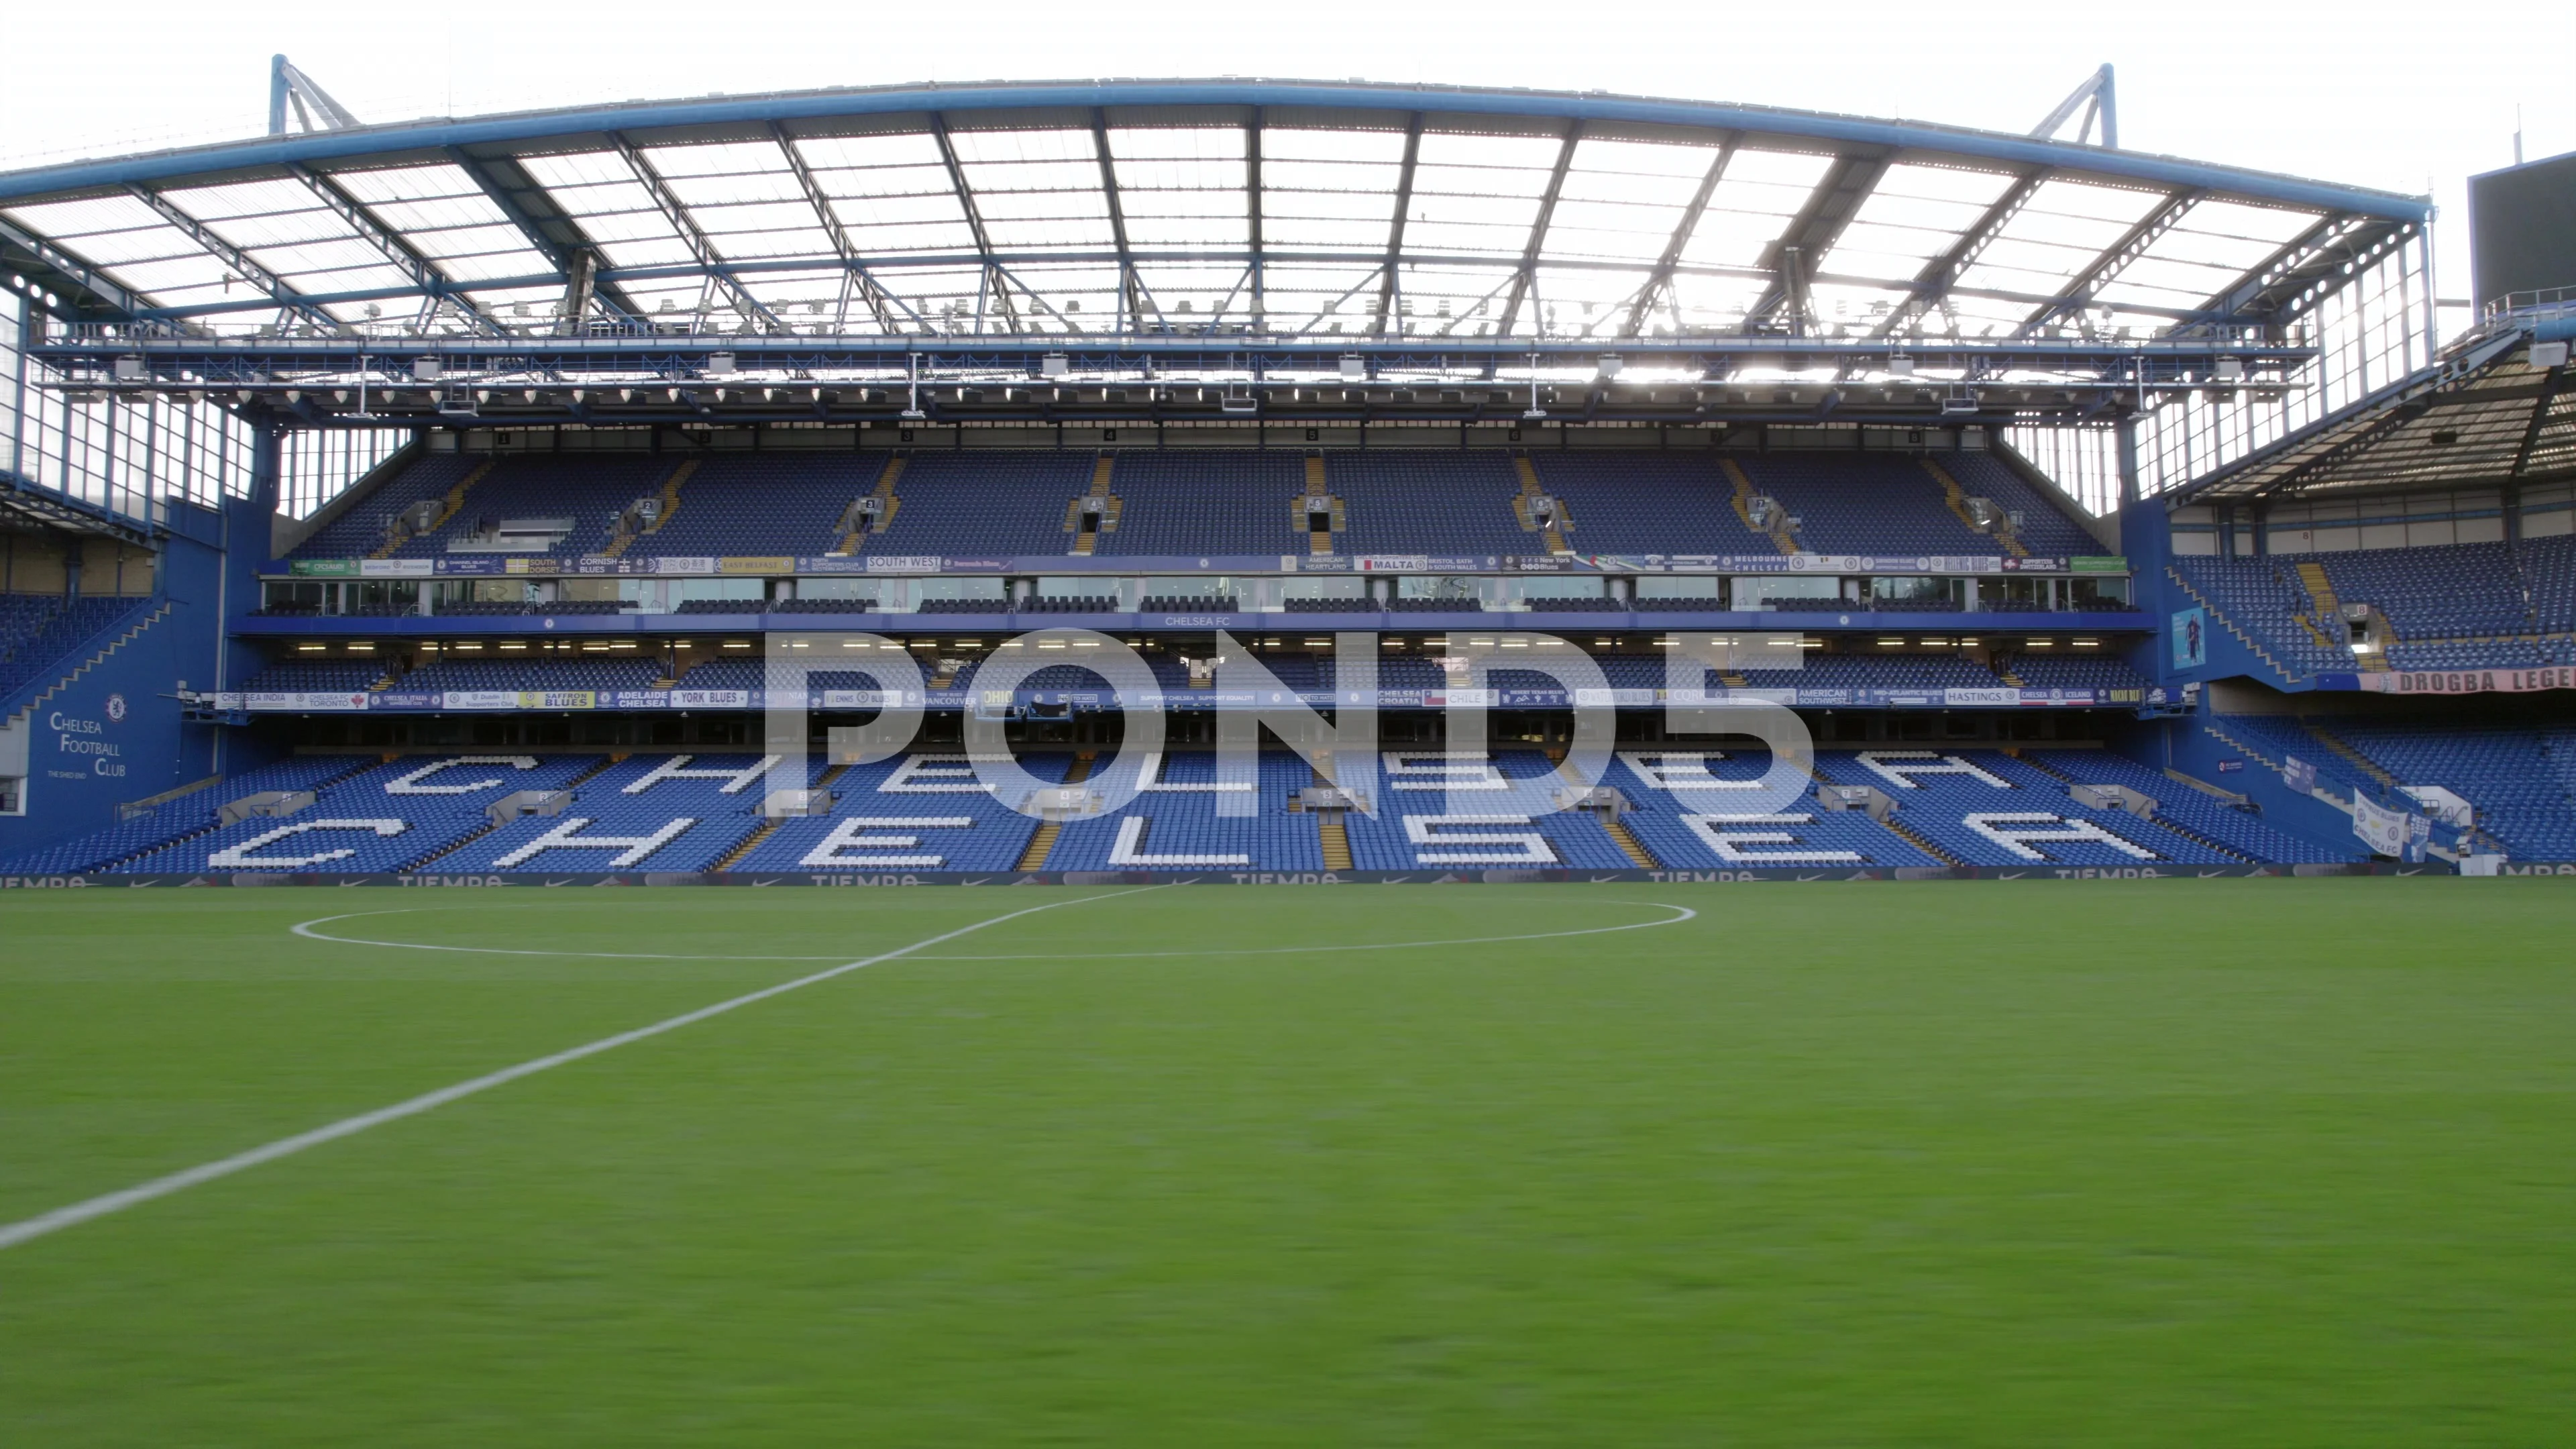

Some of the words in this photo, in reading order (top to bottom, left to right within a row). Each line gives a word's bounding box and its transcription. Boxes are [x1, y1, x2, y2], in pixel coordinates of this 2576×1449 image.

[904, 432, 910, 441] 3
[1106, 431, 1114, 439] 4
[1309, 431, 1316, 439] 5
[1511, 431, 1518, 439] 6
[1911, 433, 1917, 442] 8
[869, 557, 906, 566] SOUTH
[910, 557, 939, 566] WEST
[2359, 606, 2365, 614] 8
[1165, 617, 1214, 626] CHELSEA
[1216, 617, 1230, 626] FC
[2400, 673, 2496, 692] DROGBA
[2512, 669, 2576, 690] LEGE
[263, 693, 285, 701] INDIA
[681, 692, 704, 703] YORK
[709, 692, 737, 703] BLUES
[983, 690, 1014, 704] OHIO
[1449, 695, 1481, 703] CHILE
[1673, 690, 1707, 701] CORK
[1948, 690, 2001, 702] HASTINGS
[619, 700, 667, 708] CHELSEA
[50, 712, 102, 735] CHELSEA
[60, 733, 121, 757] FOOTBALL
[95, 758, 126, 777] CLUB
[384, 750, 2017, 795] CHELSEA
[48, 770, 59, 778] THE
[59, 771, 74, 779] SHED
[2359, 797, 2379, 816] CYPRUS
[2381, 813, 2400, 822] BLUES
[209, 812, 2158, 869] CHELSEA
[2354, 824, 2385, 852] CHELSEA
[2386, 845, 2398, 854] FC
